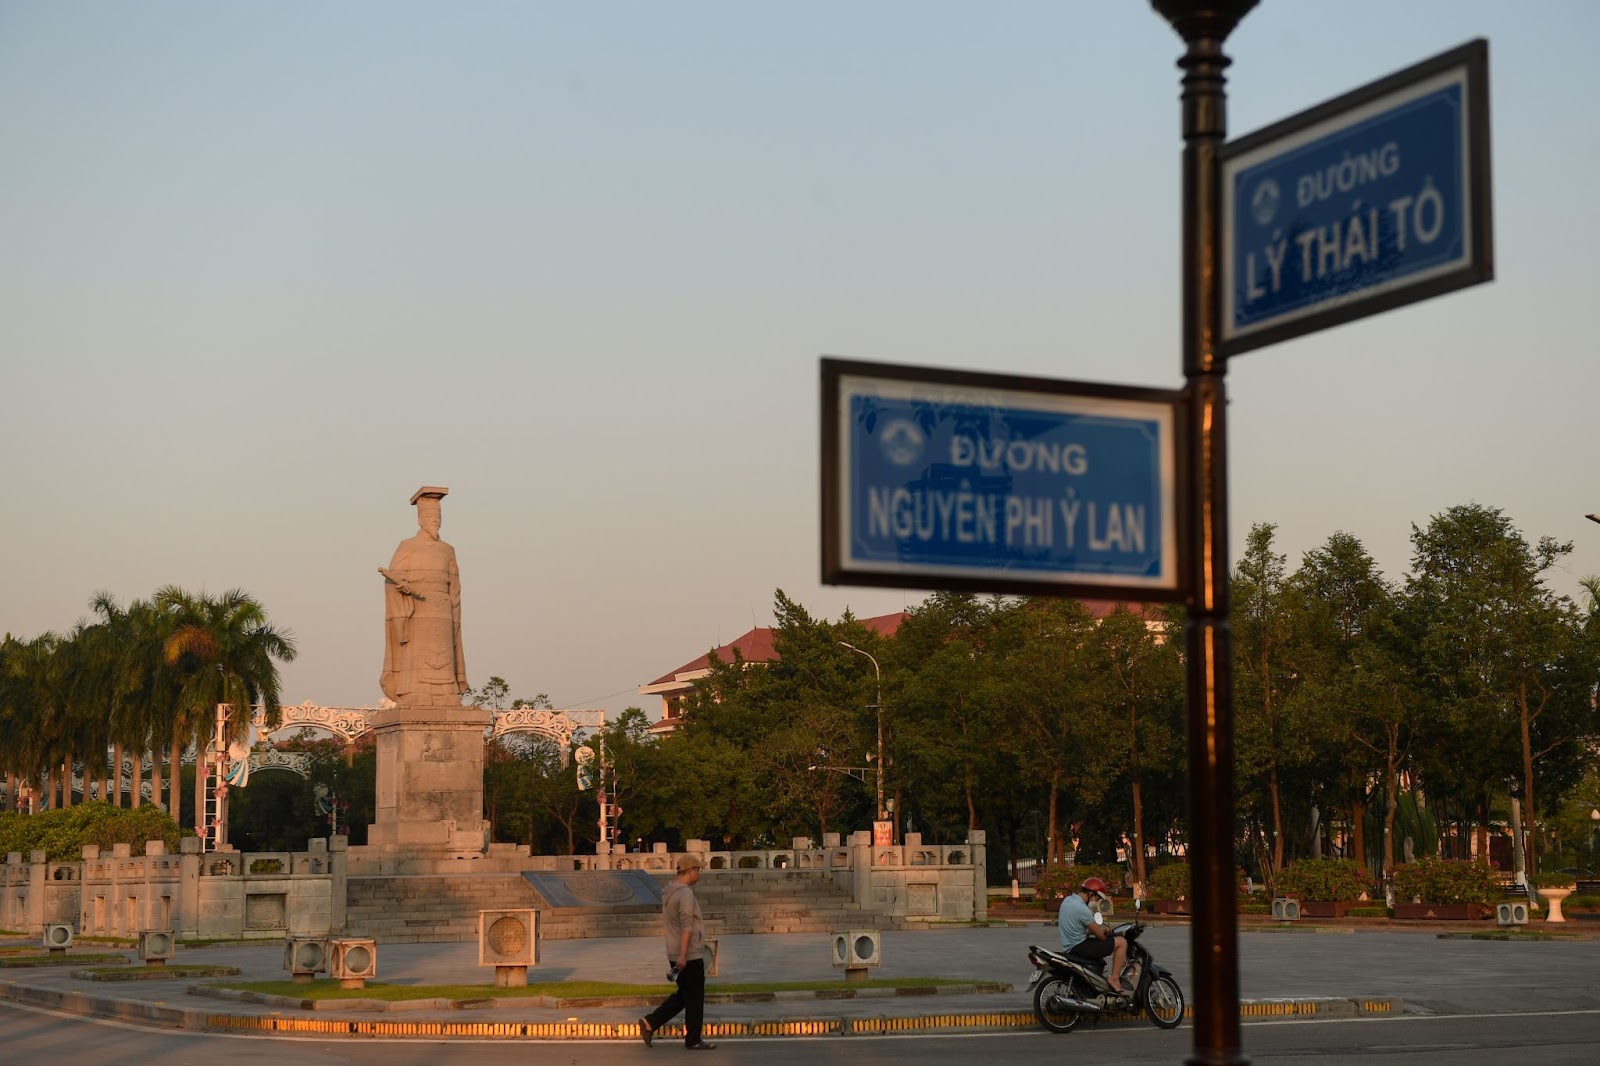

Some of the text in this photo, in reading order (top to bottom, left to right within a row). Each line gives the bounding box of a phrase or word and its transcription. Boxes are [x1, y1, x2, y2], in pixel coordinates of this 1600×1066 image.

[1297, 141, 1400, 208] ĐƯỜNG
[1246, 229, 1287, 300] LÝ
[1296, 200, 1379, 282] THÁI
[950, 431, 1088, 475] ĐƯỜNG
[867, 477, 996, 543] NGUYÊN
[1005, 493, 1051, 548] PHI
[1086, 500, 1146, 553] LAN
